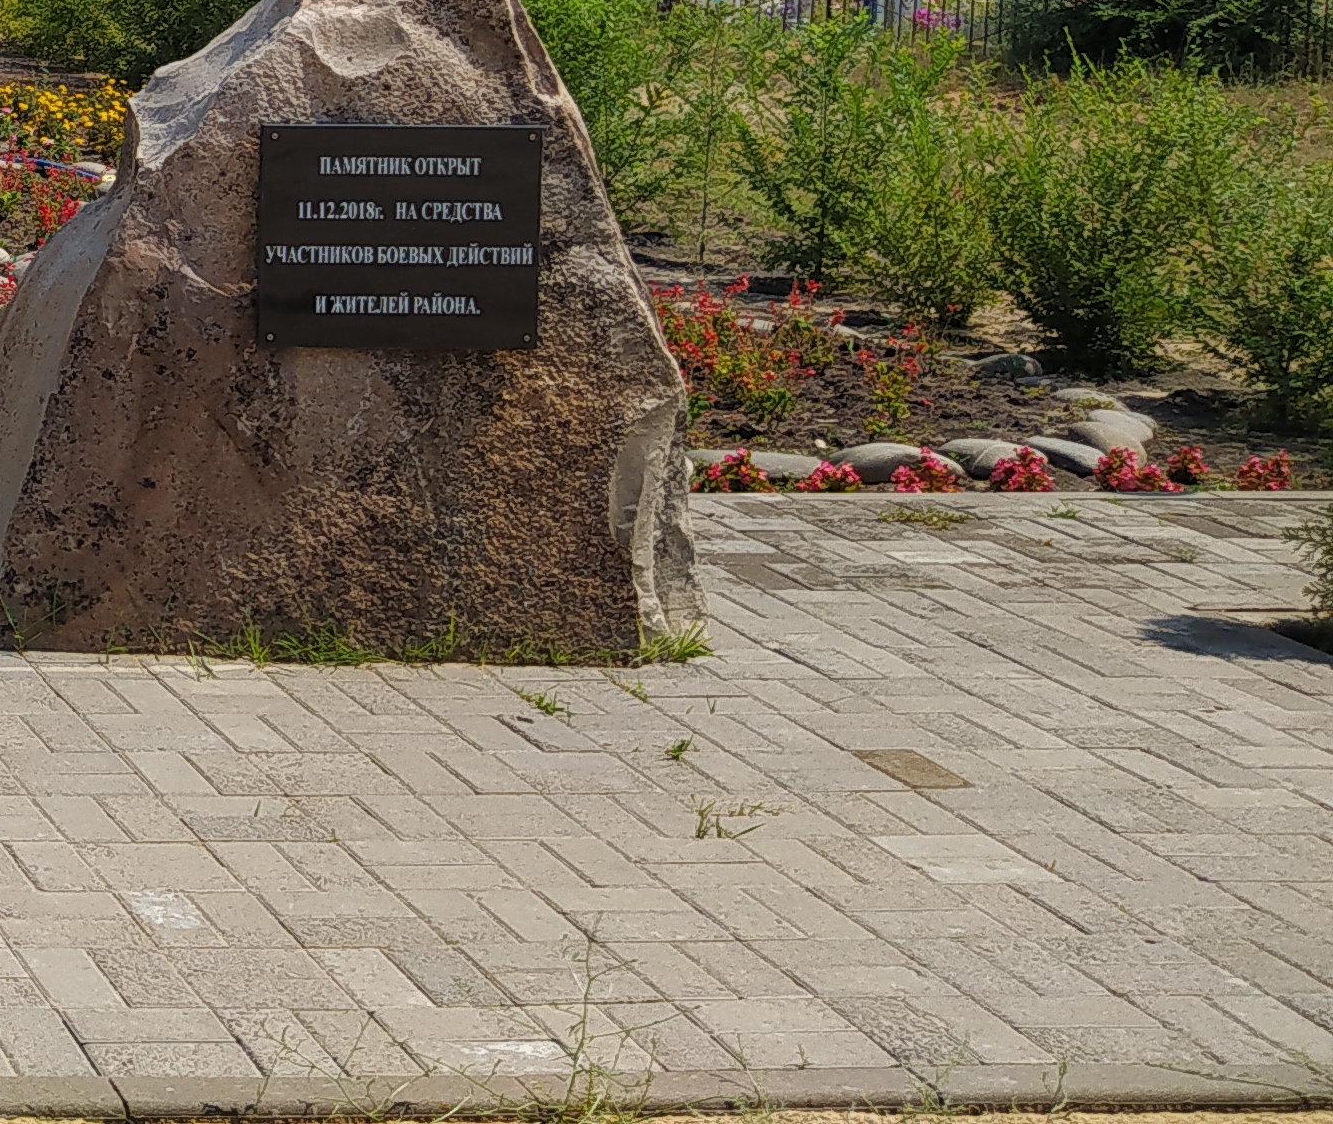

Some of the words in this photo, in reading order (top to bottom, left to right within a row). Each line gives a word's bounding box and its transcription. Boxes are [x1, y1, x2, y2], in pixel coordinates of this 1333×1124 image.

[319, 156, 412, 176] ПАМЯТНИК
[414, 157, 483, 176] ОТКРЫТ
[297, 201, 384, 221] 11.12.2018г.
[395, 202, 418, 221] НА
[421, 201, 504, 223] СРЕДСТВА
[265, 245, 374, 265] УЧАСТНИКОВ
[377, 245, 444, 265] БОЕВЫХ
[446, 241, 534, 267] ДЕЙСТВИЙ
[315, 295, 327, 315] И
[330, 291, 410, 315] ЖИТЕЛЕЙ
[413, 292, 482, 315] РАЙОНА.
